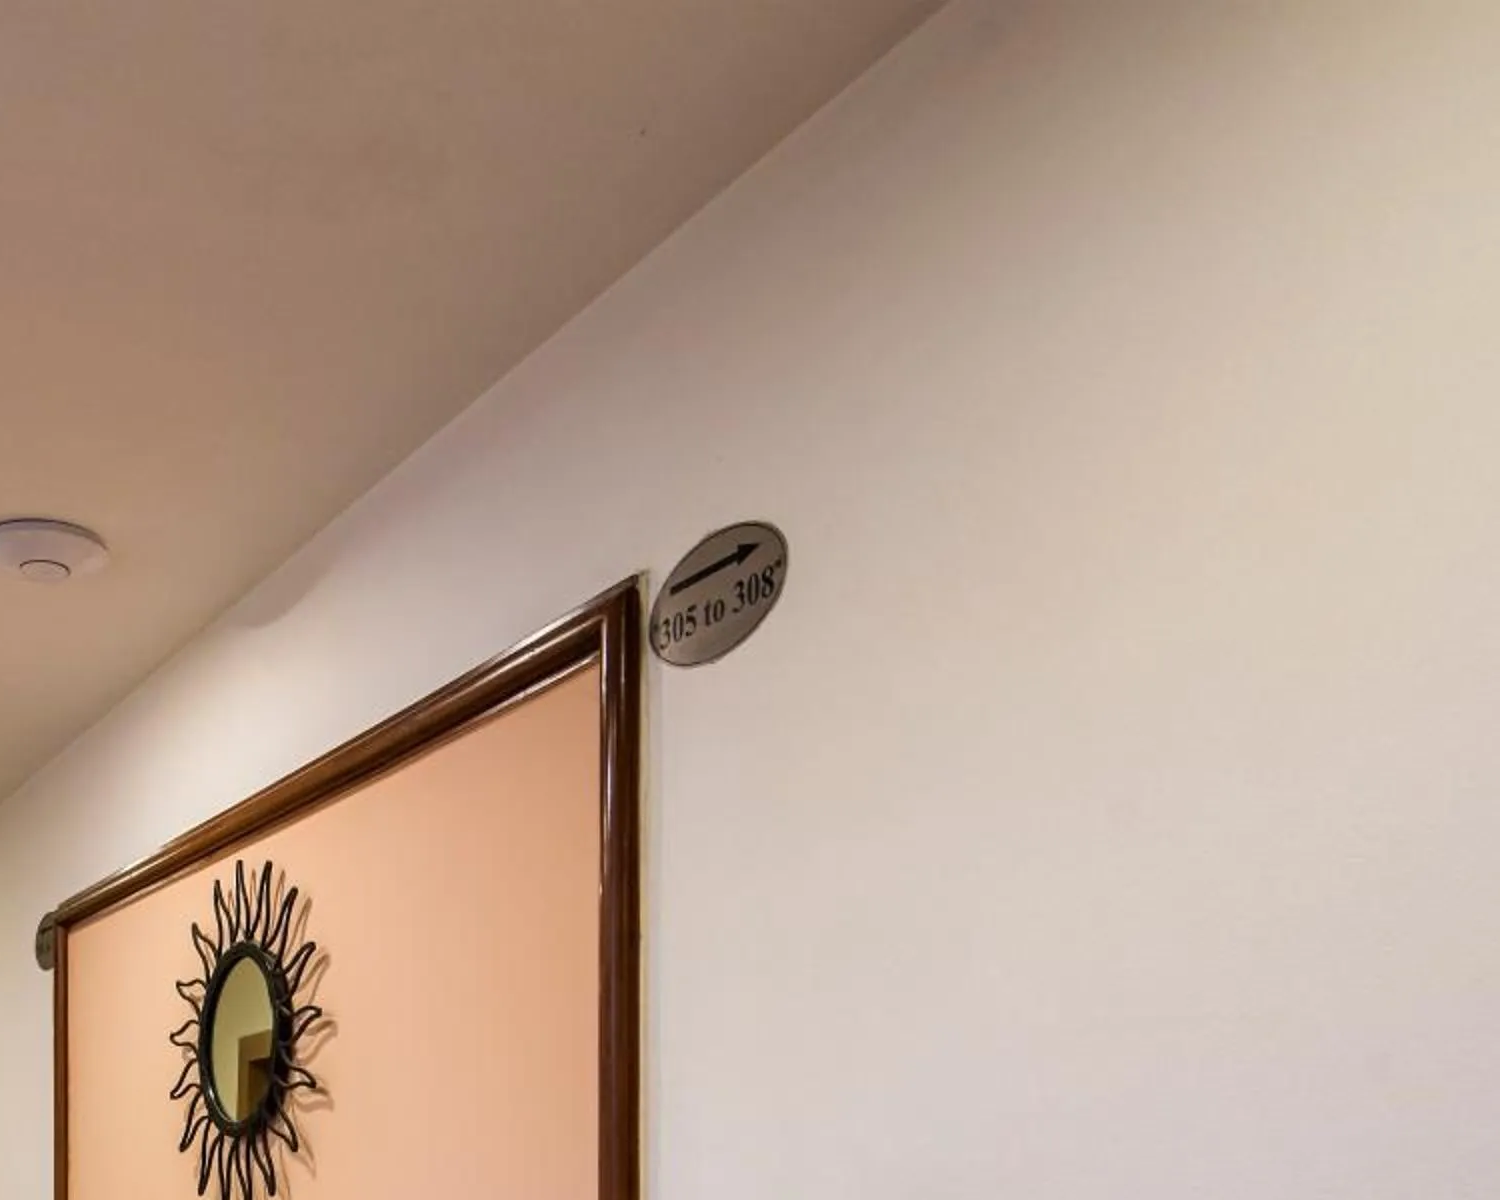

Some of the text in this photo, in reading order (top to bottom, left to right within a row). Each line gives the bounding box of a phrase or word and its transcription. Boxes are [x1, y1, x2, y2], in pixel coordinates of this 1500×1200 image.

[660, 566, 775, 650] 305 to 308
